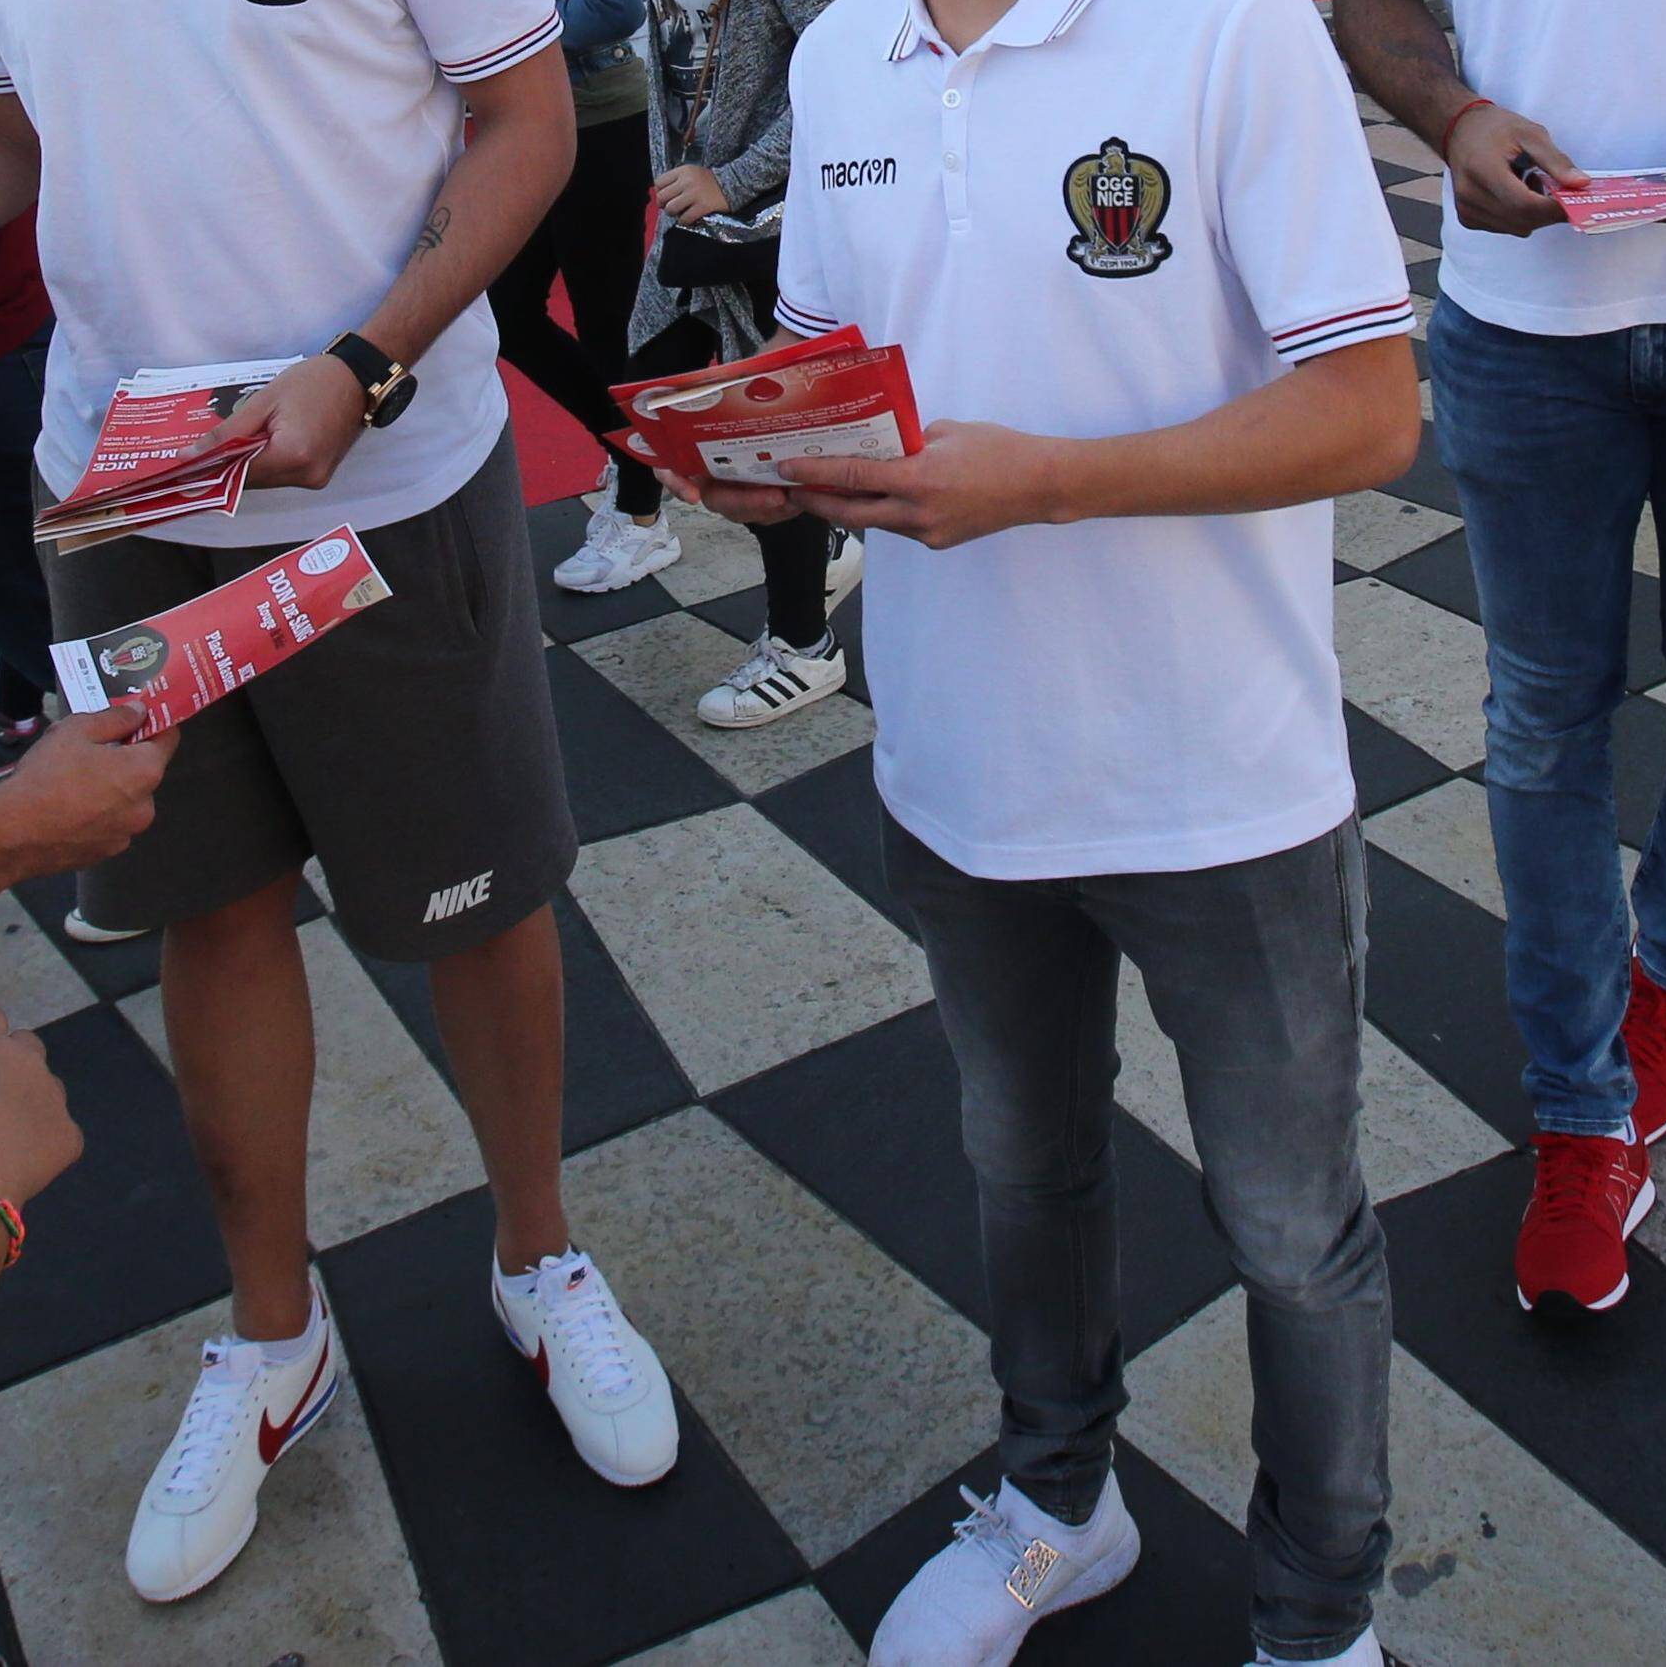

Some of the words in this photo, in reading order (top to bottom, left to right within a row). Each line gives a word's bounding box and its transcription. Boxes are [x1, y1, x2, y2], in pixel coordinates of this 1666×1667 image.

[820, 155, 898, 191] macron
[1096, 176, 1134, 191] OGC
[1096, 191, 1134, 207] NICE
[91, 460, 139, 473] NICE
[96, 448, 179, 464] Massena
[266, 568, 294, 605] DON
[255, 600, 277, 630] Rouge
[281, 603, 300, 621] DE
[288, 613, 317, 644] SANG
[205, 629, 224, 659] Place
[422, 870, 495, 924] NIKE
